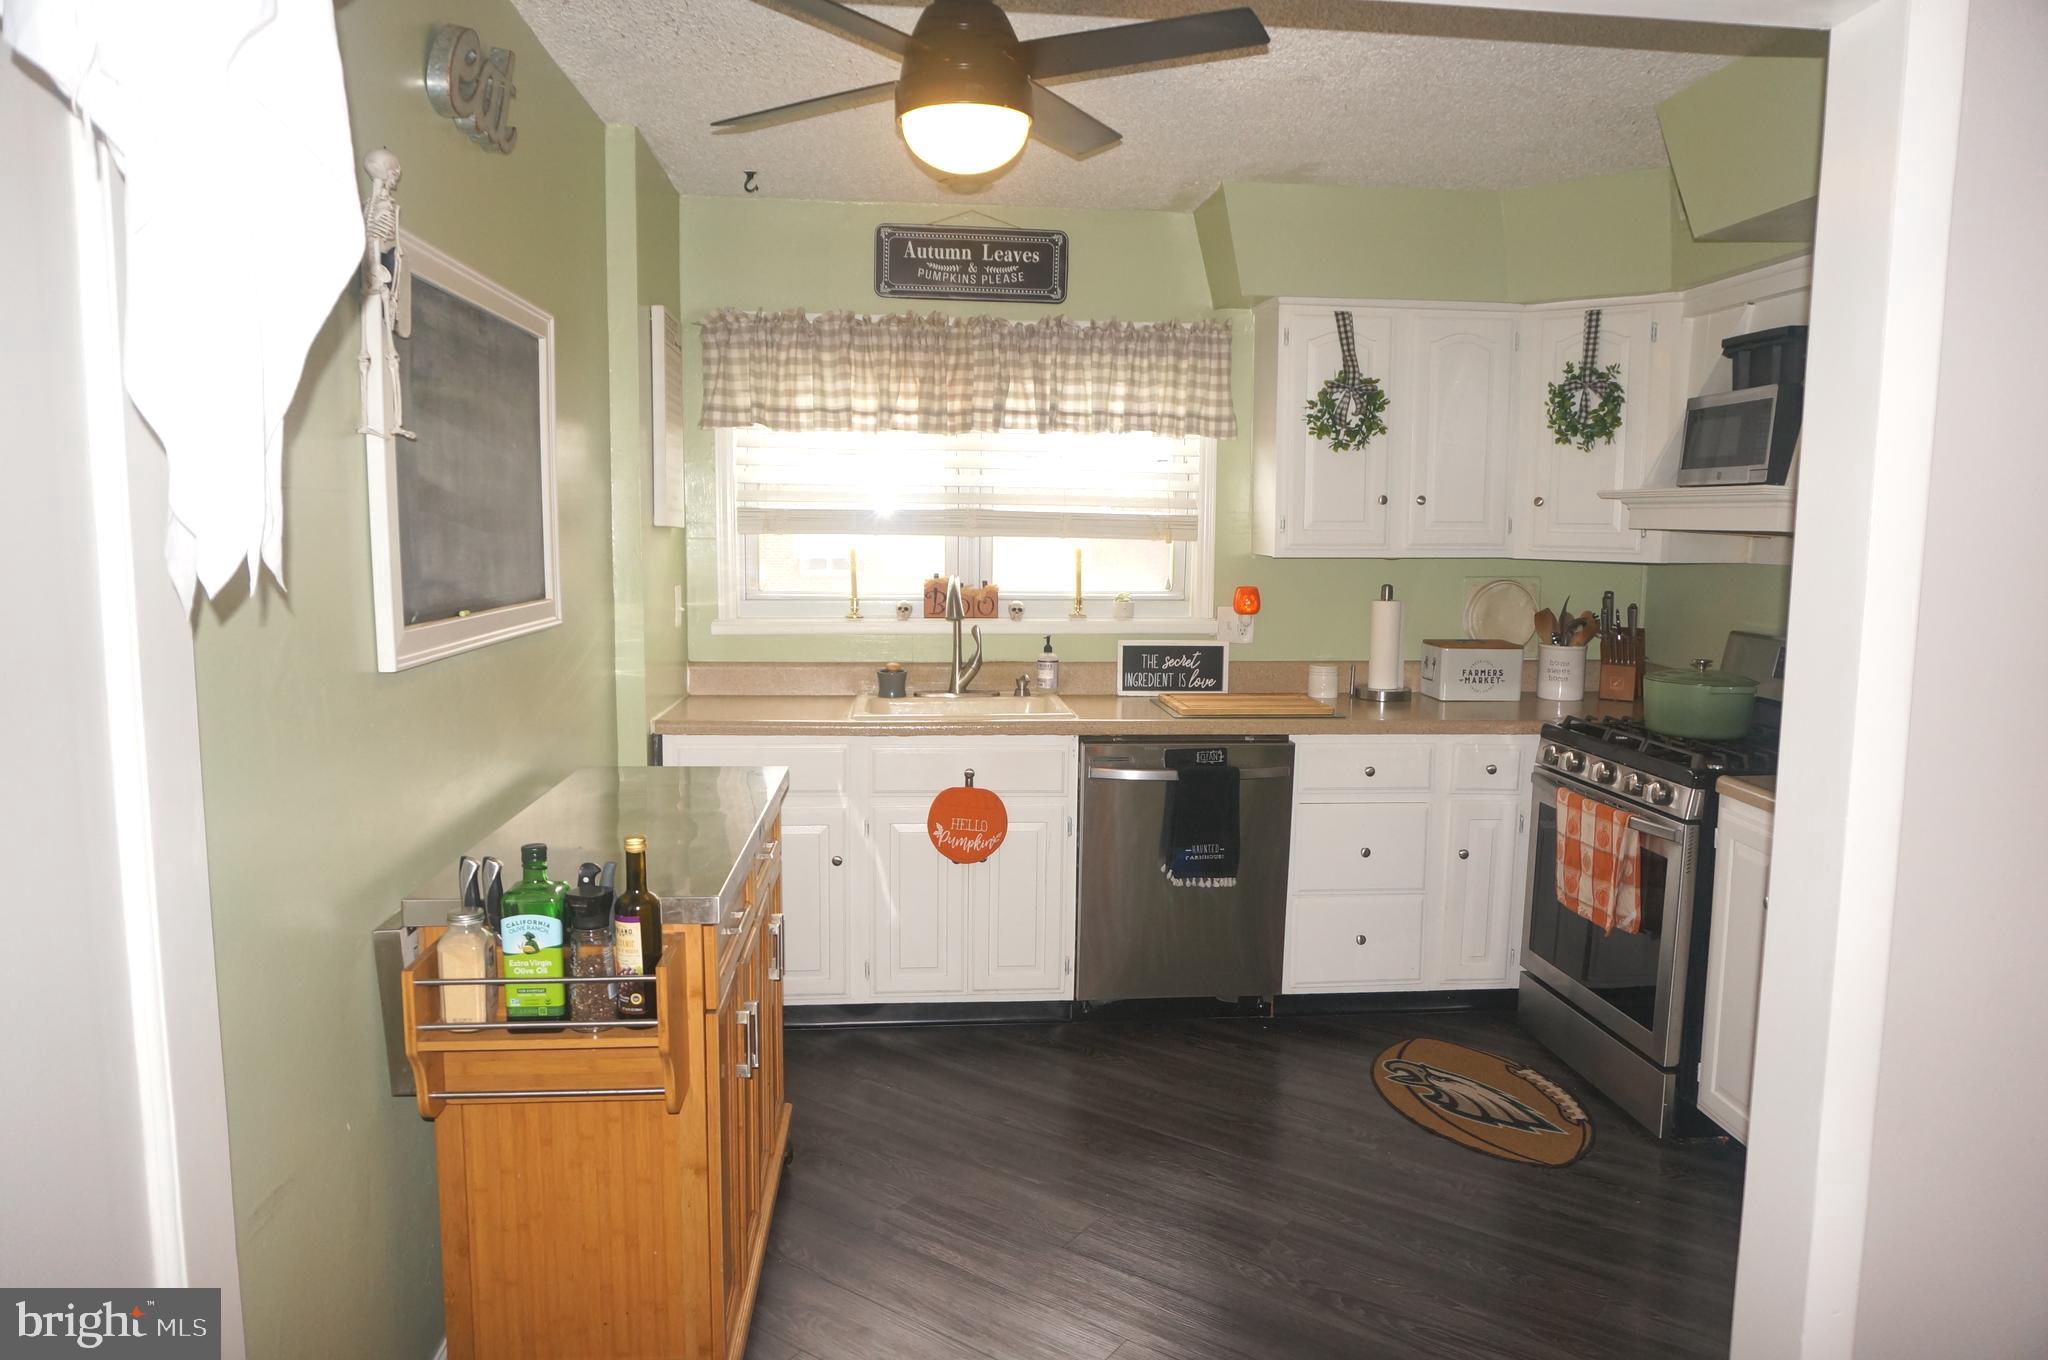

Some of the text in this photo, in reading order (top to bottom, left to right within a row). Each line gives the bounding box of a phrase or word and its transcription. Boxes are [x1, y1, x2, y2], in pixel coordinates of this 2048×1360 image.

[430, 24, 517, 155] eat
[903, 240, 1040, 263] Autumn Leaves
[967, 262, 978, 273] &
[917, 267, 1025, 285] PUMPKINS PLEASE
[1142, 651, 1201, 669] THE secret
[1124, 668, 1217, 689] INGREDIENT IS love
[1462, 669, 1504, 677] FARMERS
[1464, 676, 1501, 684] MARKET
[951, 817, 989, 832] HELLO
[1191, 844, 1220, 854] HAUNTED
[505, 919, 551, 929] CALIFORNIA
[529, 959, 553, 968] Virgin
[513, 967, 549, 975] Olive Oil
